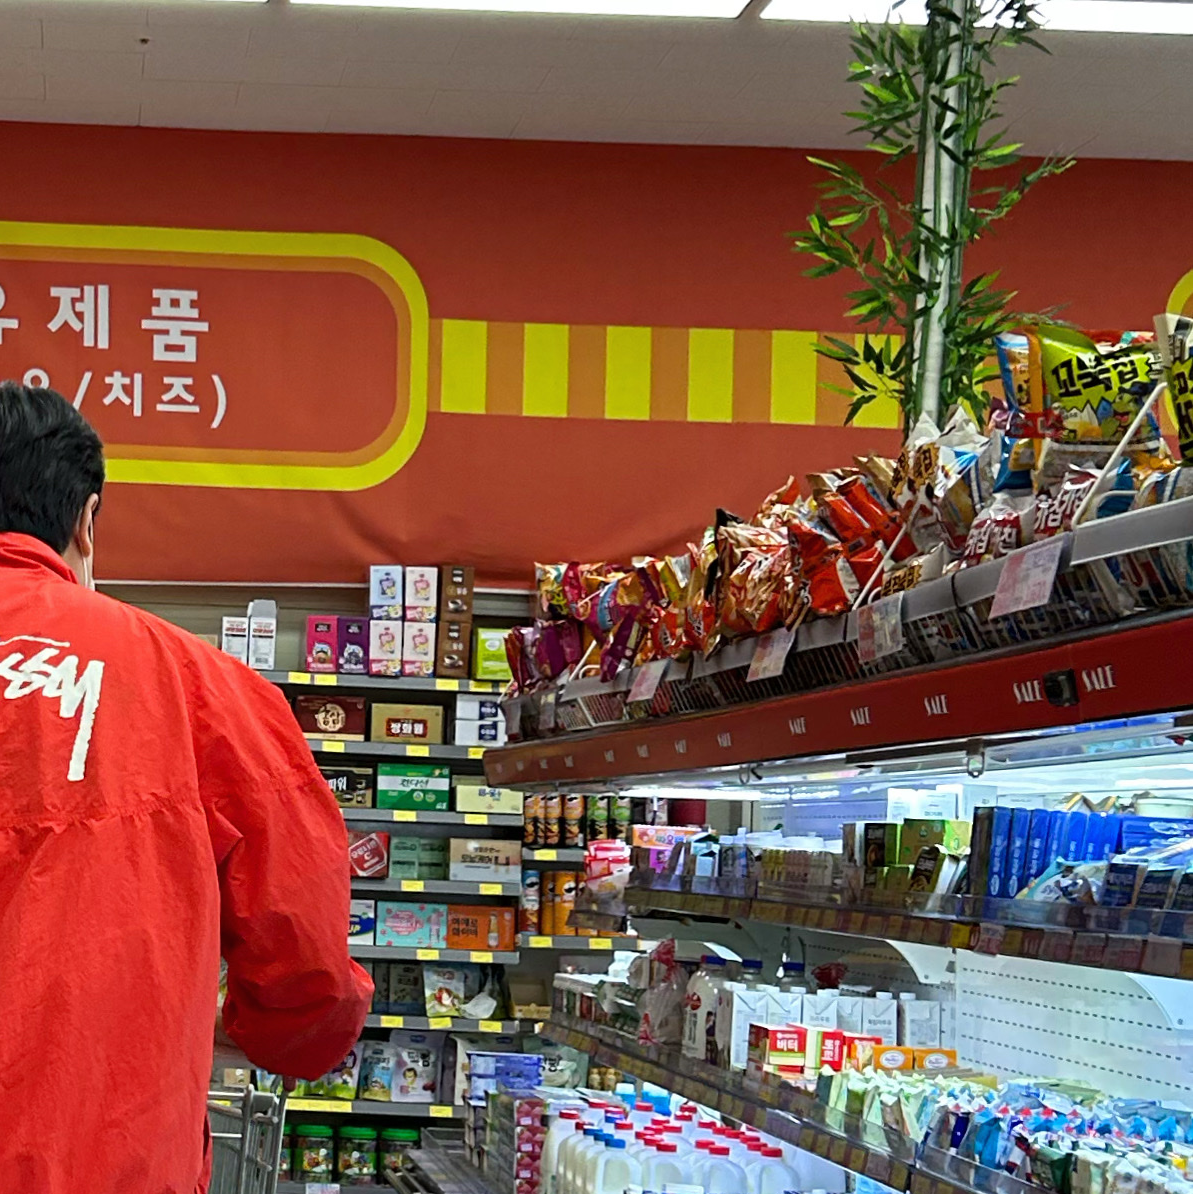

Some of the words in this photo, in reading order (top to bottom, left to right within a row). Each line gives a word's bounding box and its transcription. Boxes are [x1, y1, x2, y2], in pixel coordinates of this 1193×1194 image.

[1082, 665, 1118, 692] SALE
[1013, 680, 1044, 704] SALE
[924, 695, 949, 716] SALE
[399, 778, 430, 788] 컨디션
[777, 1039, 798, 1052] 버터
